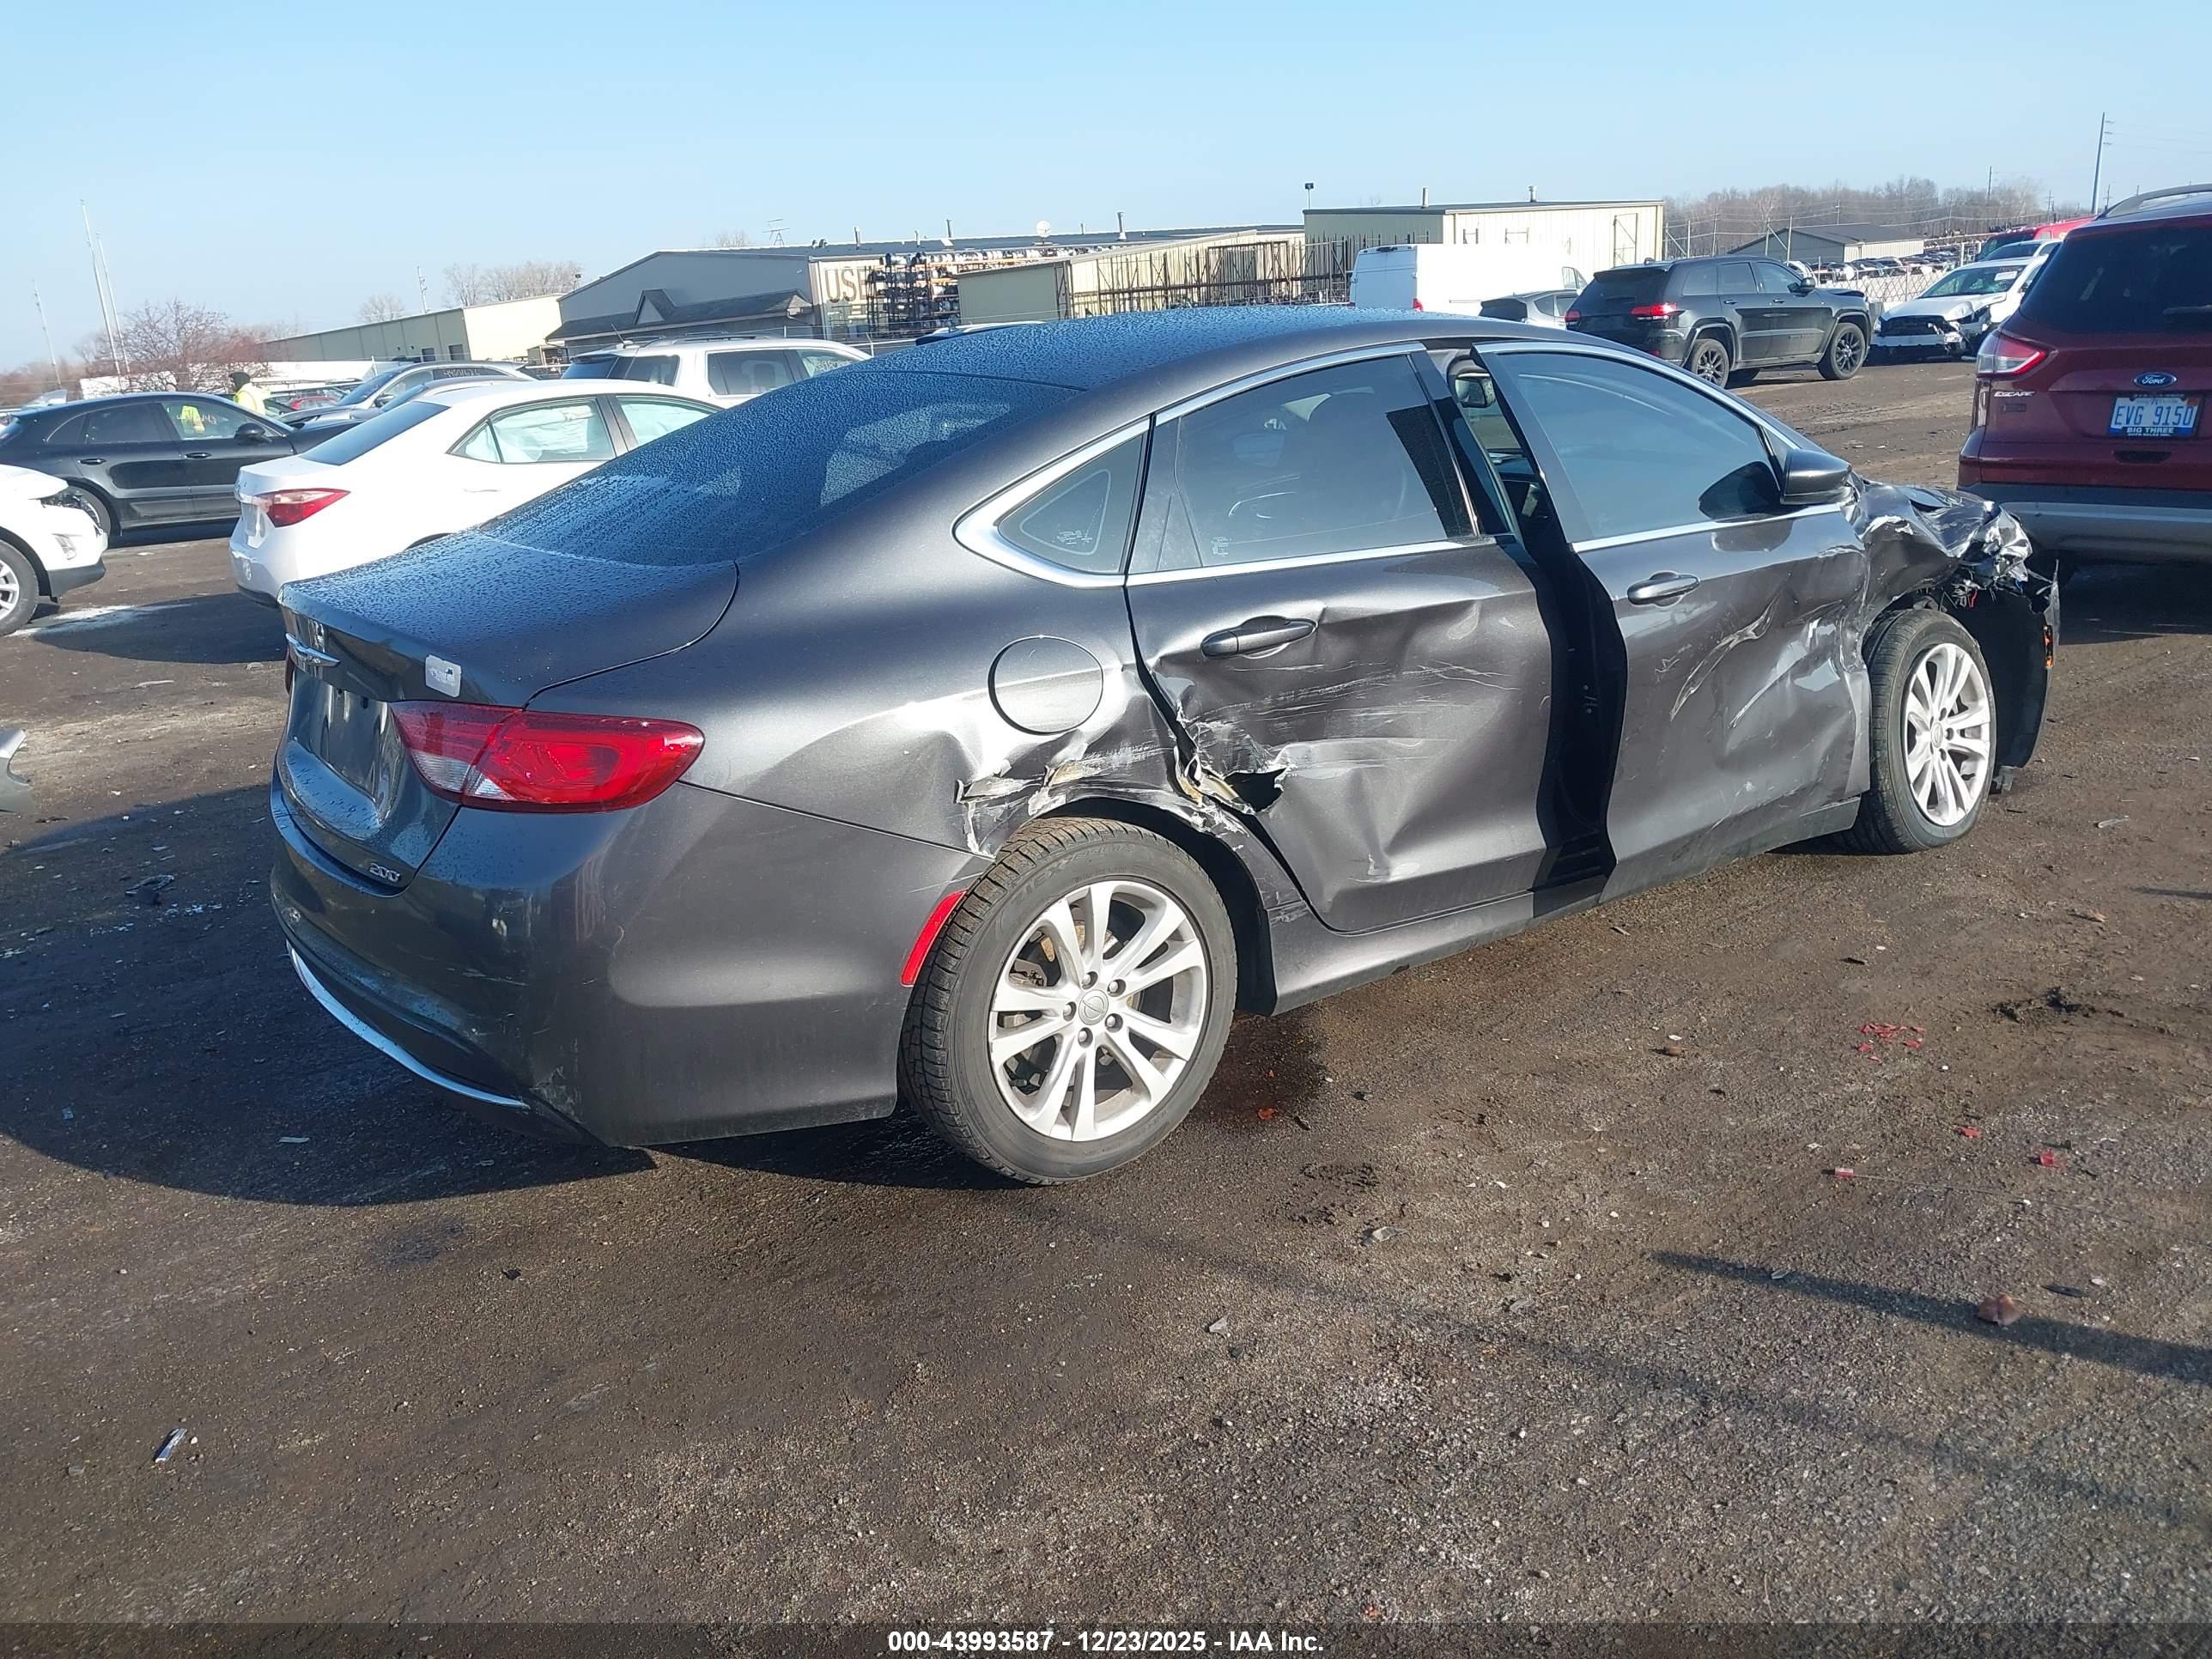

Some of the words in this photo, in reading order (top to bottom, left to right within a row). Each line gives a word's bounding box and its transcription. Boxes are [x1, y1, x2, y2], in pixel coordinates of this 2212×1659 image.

[824, 267, 867, 303] USE
[2142, 374, 2166, 385] Ford
[2114, 405, 2144, 426] EVG
[2153, 405, 2195, 426] 9150
[369, 862, 399, 883] 200
